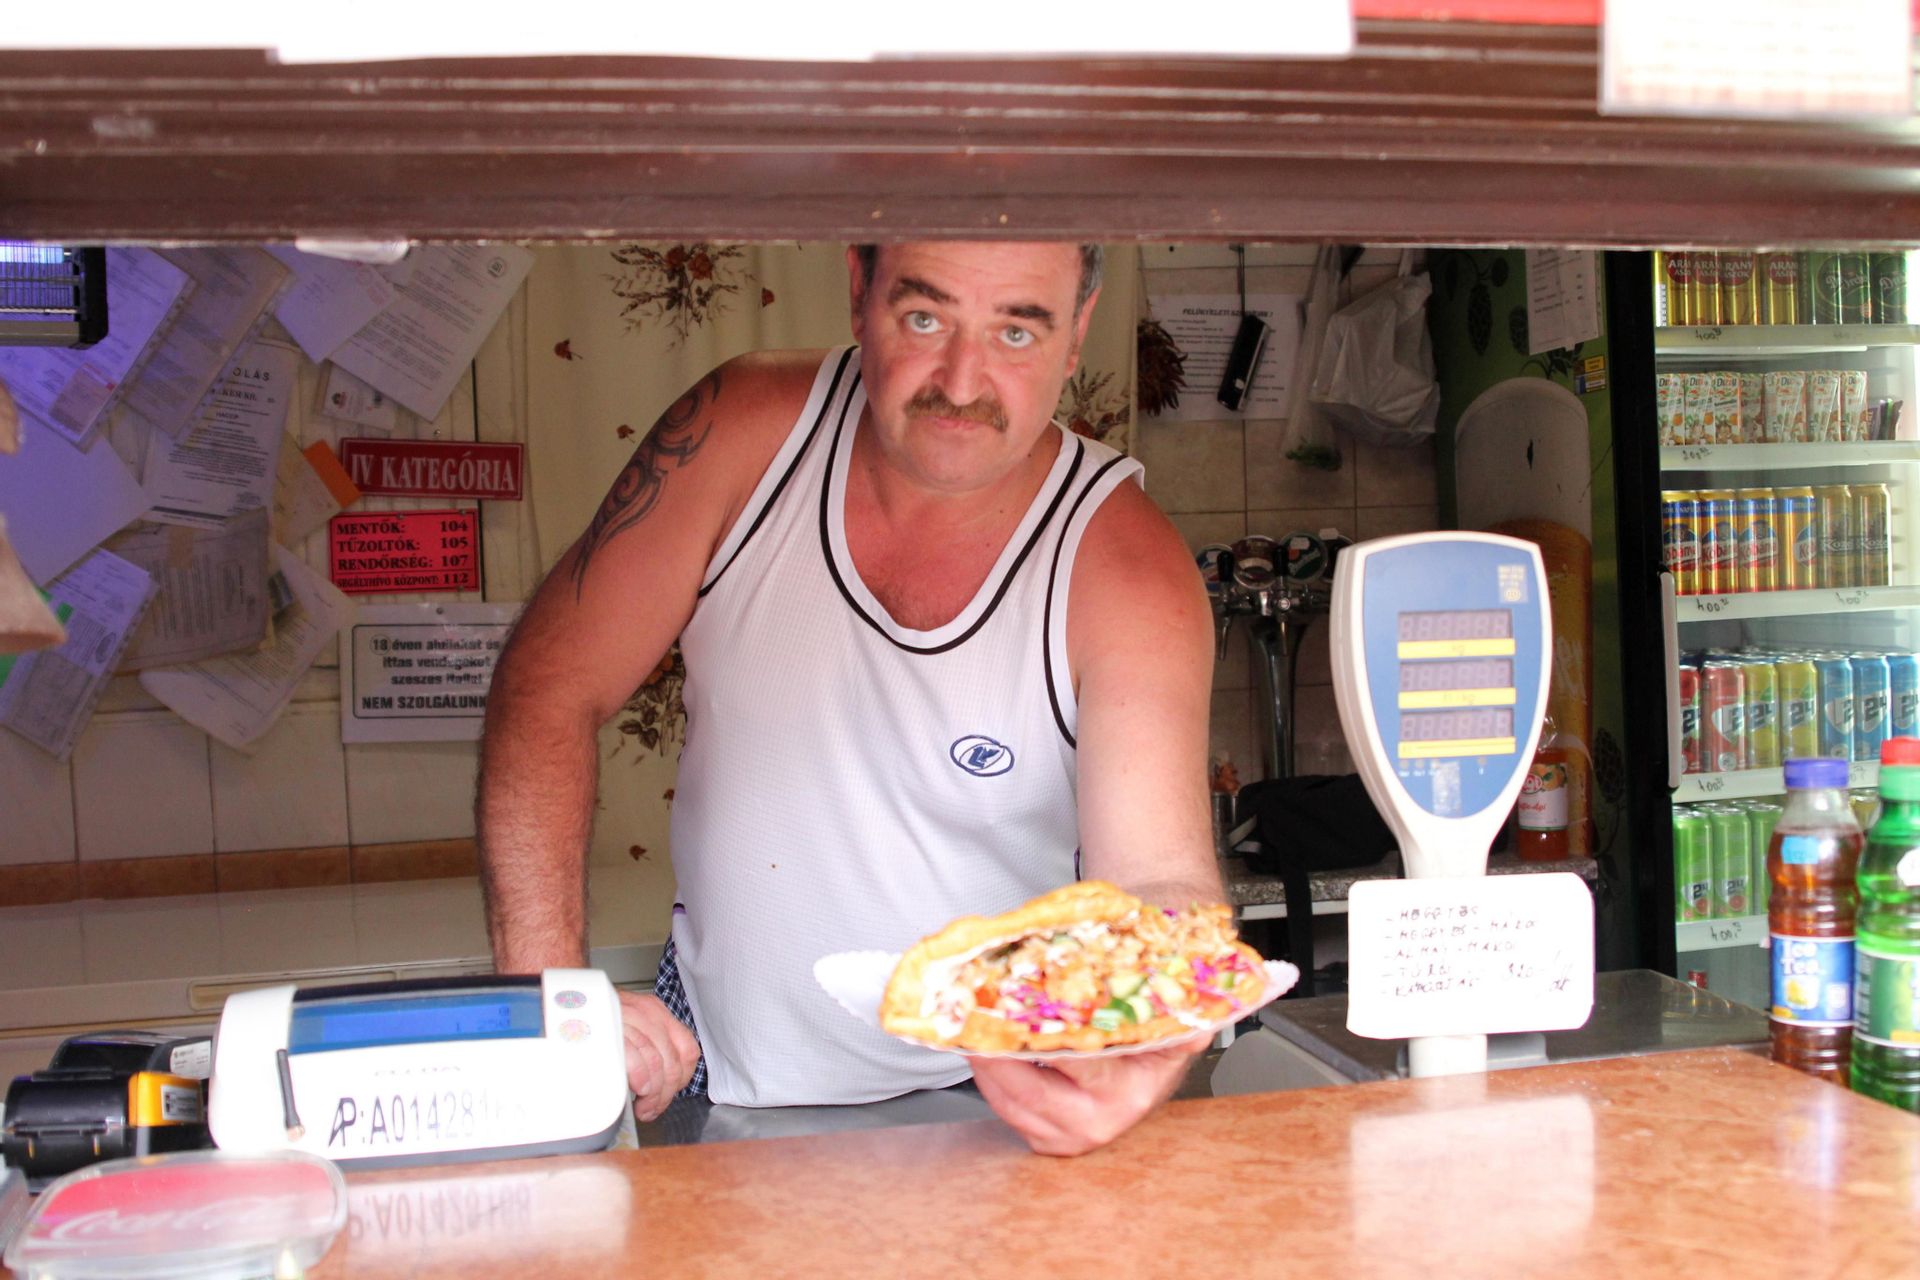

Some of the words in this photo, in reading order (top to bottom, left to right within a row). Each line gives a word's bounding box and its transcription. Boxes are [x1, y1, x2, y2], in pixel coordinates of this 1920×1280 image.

[352, 454, 374, 486] IV
[382, 452, 515, 491] KATEGÓRIA
[440, 521, 468, 532] 104
[440, 537, 468, 549] 105
[440, 555, 468, 567] 107
[442, 573, 468, 584] 112
[373, 639, 388, 650] 18
[392, 639, 422, 650] éven
[382, 656, 413, 668] ittas
[391, 675, 442, 685] szeszes
[362, 696, 393, 710] NEM
[398, 694, 488, 710] SZOLGÁLUNK
[1865, 695, 1887, 722] 24
[1693, 882, 1709, 900] 24
[1784, 941, 1817, 958] Ice
[1782, 959, 1821, 975] Tea
